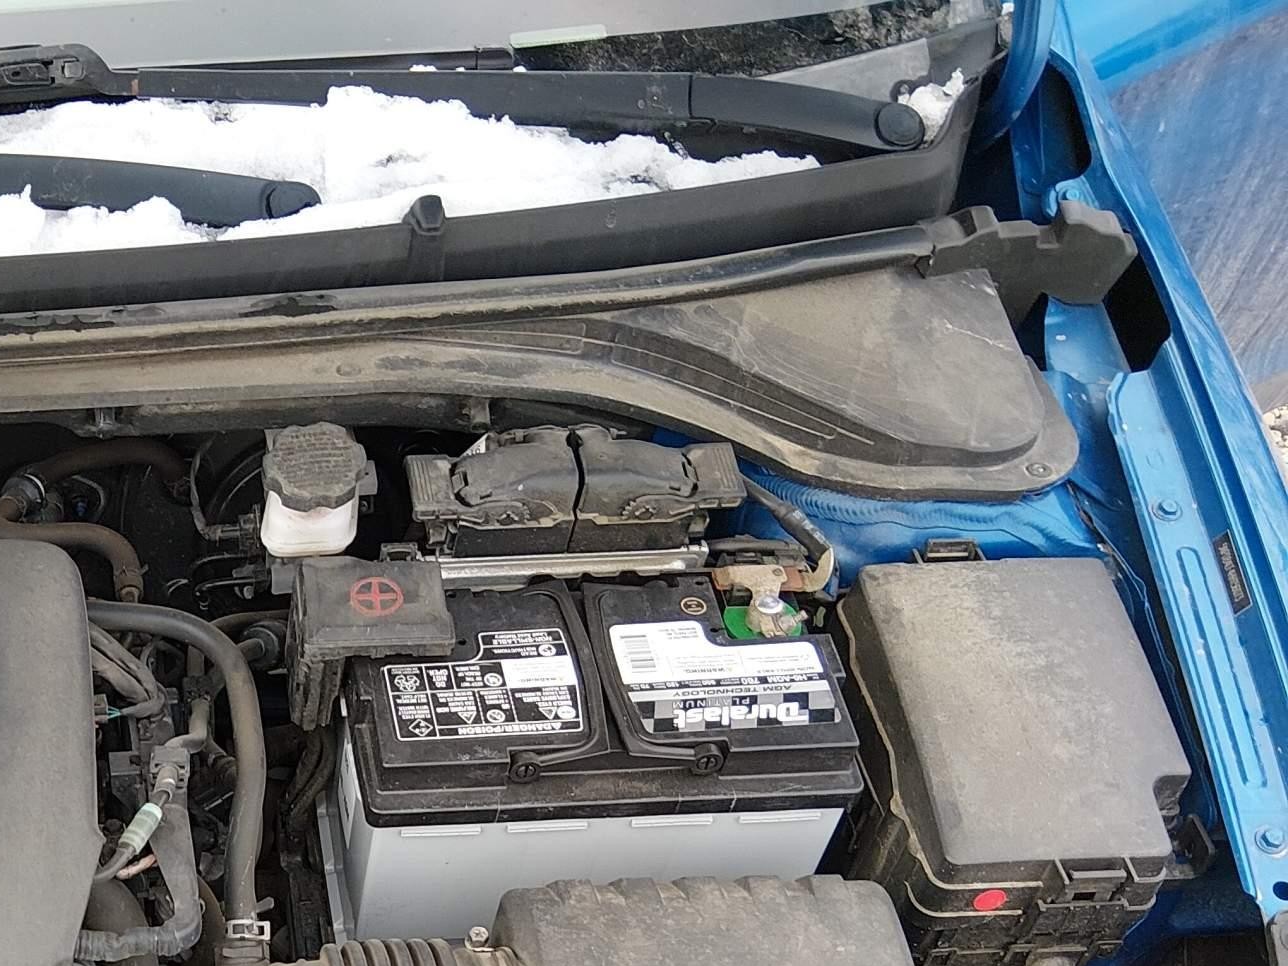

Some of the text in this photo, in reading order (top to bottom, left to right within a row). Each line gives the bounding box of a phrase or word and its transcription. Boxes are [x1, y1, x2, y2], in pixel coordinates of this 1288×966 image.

[672, 686, 759, 698] TECHNOLOGY
[761, 685, 792, 693] AGM
[672, 697, 750, 710] PLATINUM
[673, 701, 809, 729] Duralast
[458, 722, 553, 735] DANGER/POISON
